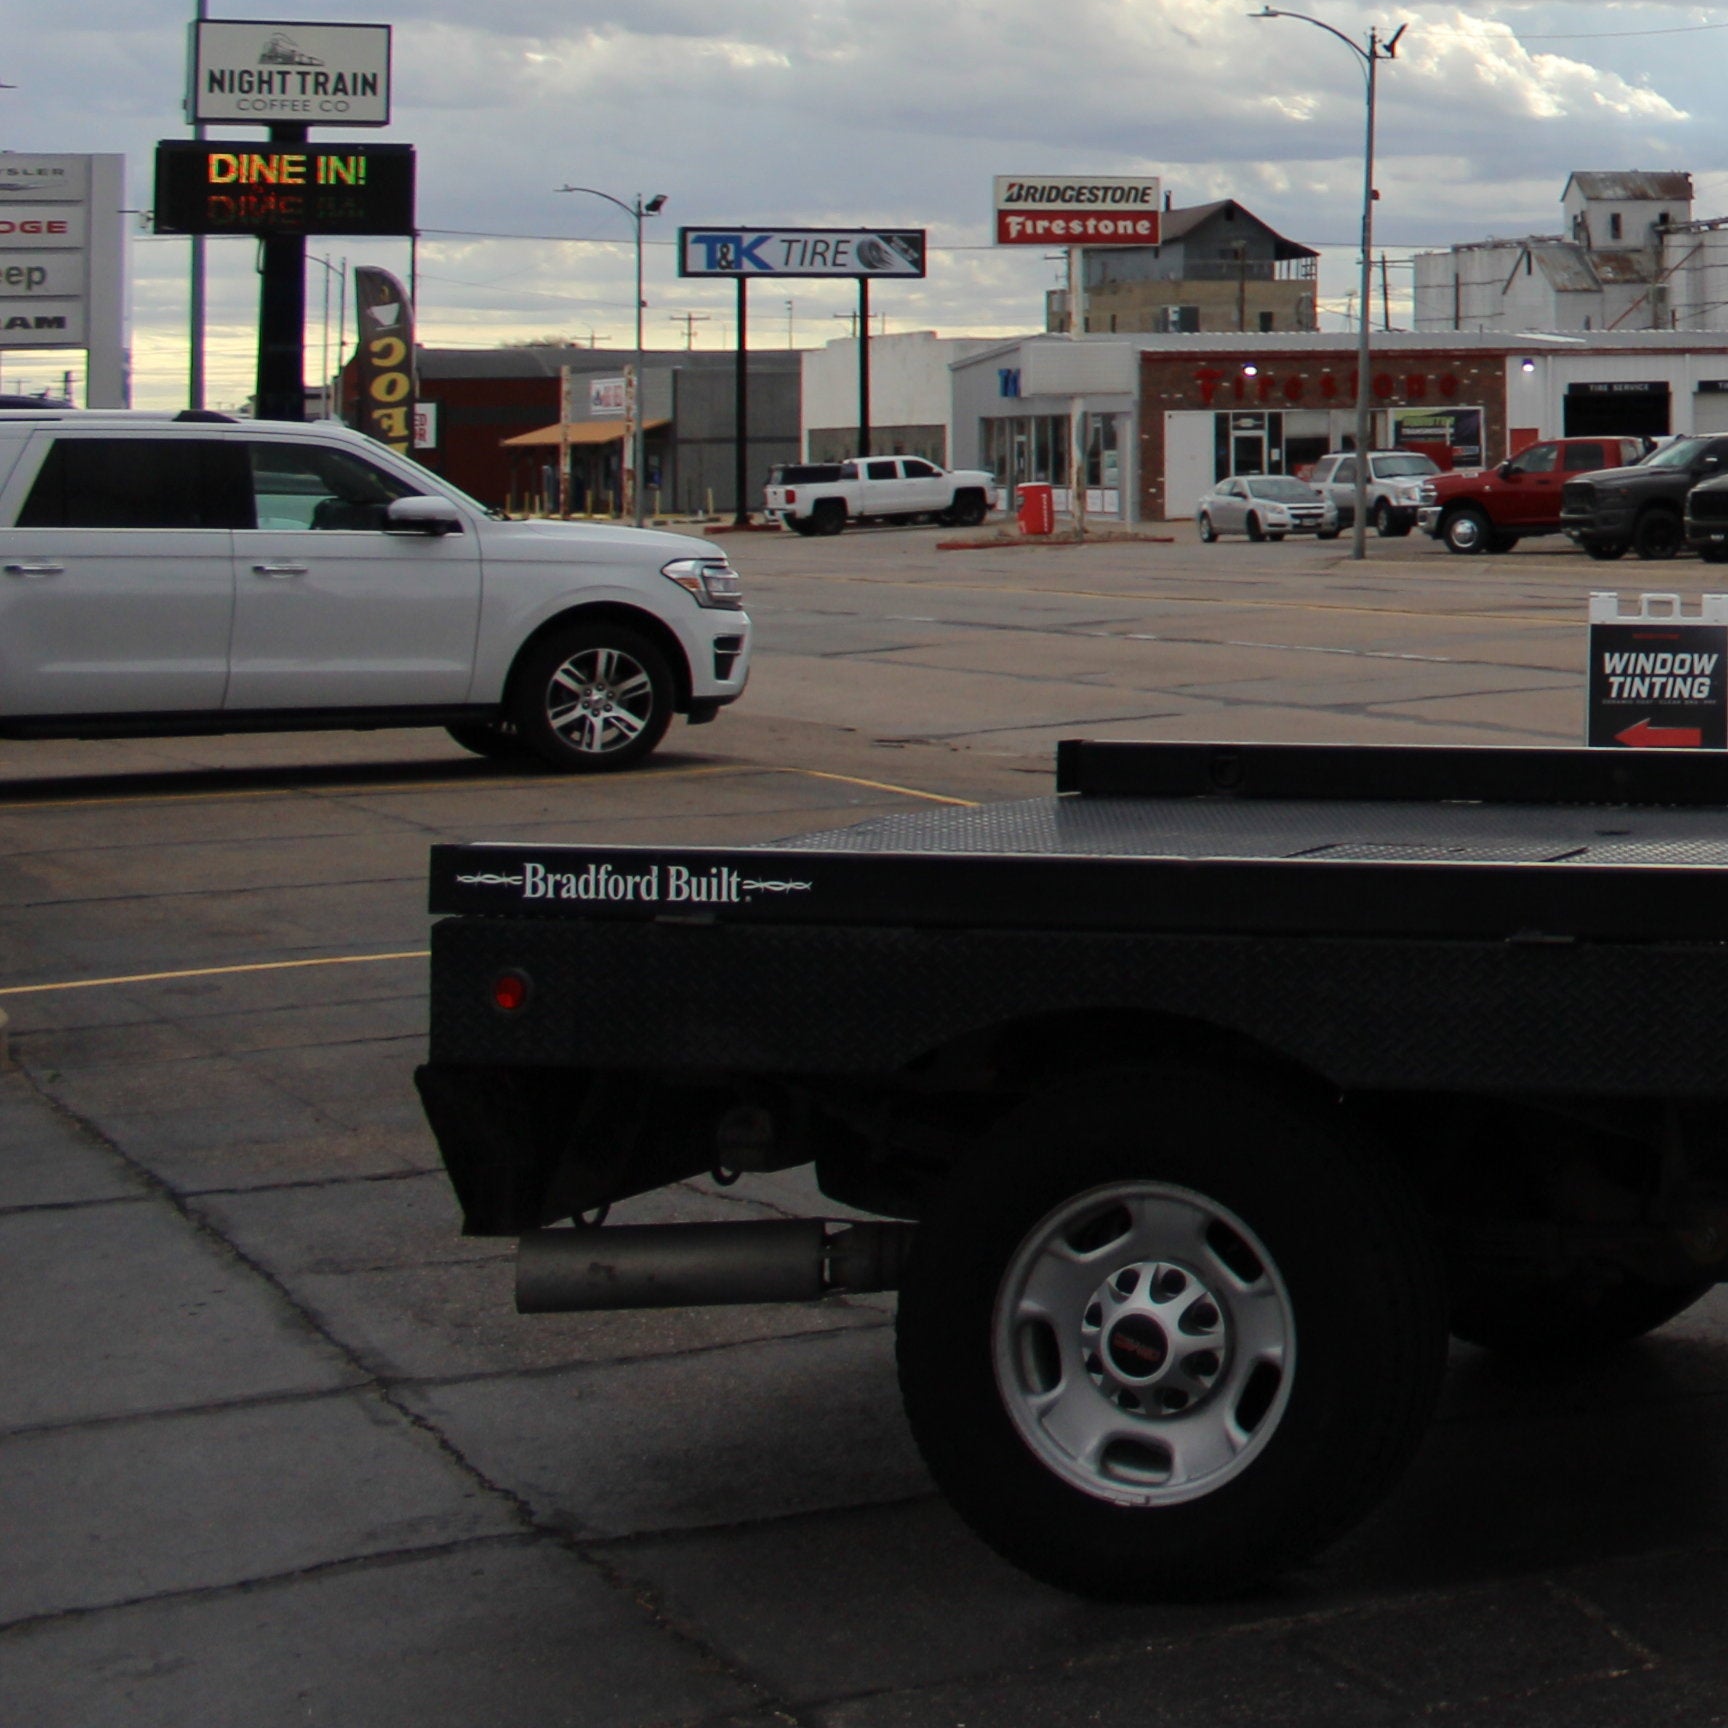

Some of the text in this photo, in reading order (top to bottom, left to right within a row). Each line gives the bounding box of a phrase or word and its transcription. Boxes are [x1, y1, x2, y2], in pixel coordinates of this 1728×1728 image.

[208, 69, 378, 96] NIGHT TRAIN
[236, 99, 350, 112] COFFEE CO
[0, 168, 65, 176] SLER
[207, 153, 367, 185] DINE IN!
[1005, 183, 1153, 204] BRIDGESTONE
[1006, 215, 1151, 239] Firestone
[691, 235, 850, 271] T&K TIRE
[0, 265, 48, 291] ep
[0, 316, 67, 330] AM
[1604, 652, 1719, 675] WINDOW
[1609, 677, 1711, 699] TINTING
[522, 862, 740, 903] Bradford Built
